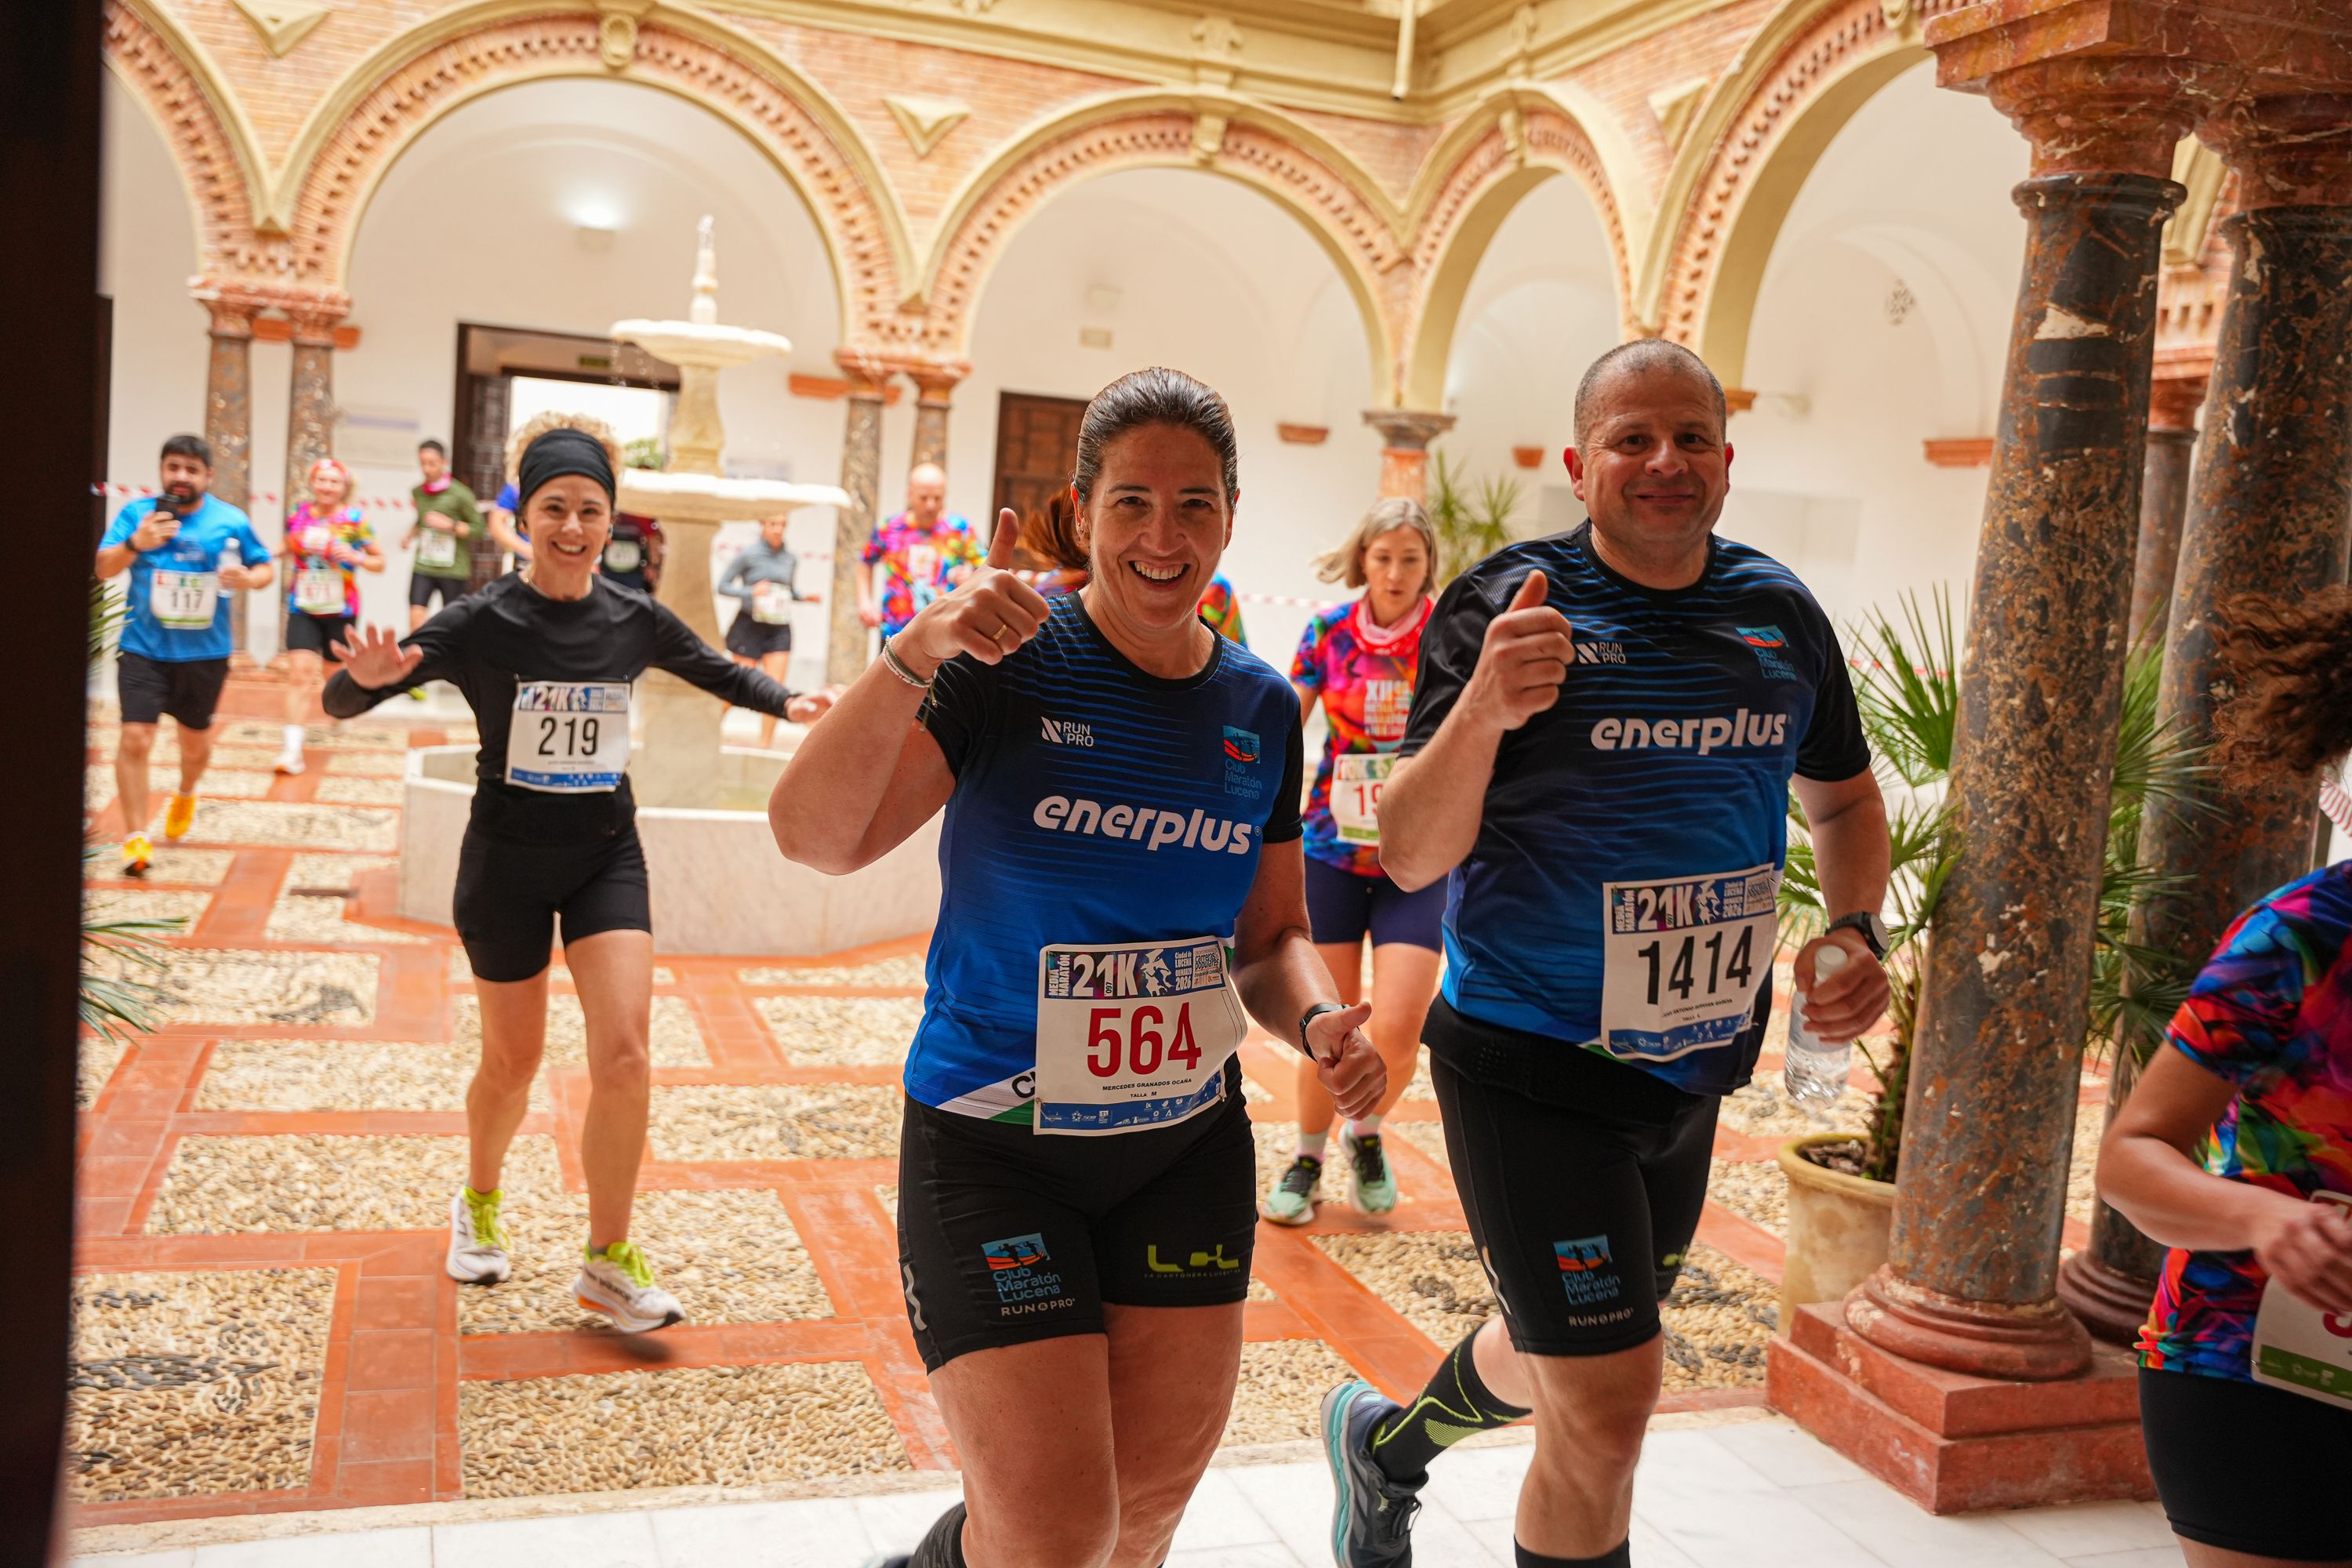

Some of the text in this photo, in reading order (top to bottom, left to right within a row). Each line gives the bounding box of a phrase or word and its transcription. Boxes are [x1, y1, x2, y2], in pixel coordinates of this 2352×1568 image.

[171, 590, 203, 609] 117
[1599, 641, 1623, 654] RUN
[1755, 647, 1777, 659] Club
[1602, 652, 1627, 664] PRO
[538, 717, 599, 756] 219
[1062, 721, 1091, 735] RUN
[1591, 708, 1787, 756] enerplus
[1065, 733, 1094, 747] PRO
[1225, 757, 1246, 774] Club
[1225, 770, 1262, 789] Maratón
[1225, 782, 1261, 800] Lucena
[1033, 795, 1253, 855] enerplus
[1638, 884, 1693, 931] 21K
[1175, 957, 1192, 968] LUCENA
[1196, 953, 1215, 963] carreras
[1196, 959, 1219, 970] populares
[1638, 925, 1753, 1005] 1414
[1048, 969, 1059, 996] MEDIA
[1057, 954, 1070, 996] MARATÓN
[1073, 953, 1138, 996] 21K
[1176, 975, 1191, 991] 2026
[1087, 1001, 1202, 1077] 564
[993, 1266, 1032, 1282] Club
[996, 1272, 1062, 1292] Maratón
[1561, 1270, 1595, 1283] Club
[1000, 1284, 1061, 1302] Lucena
[1566, 1287, 1619, 1305] Lucena
